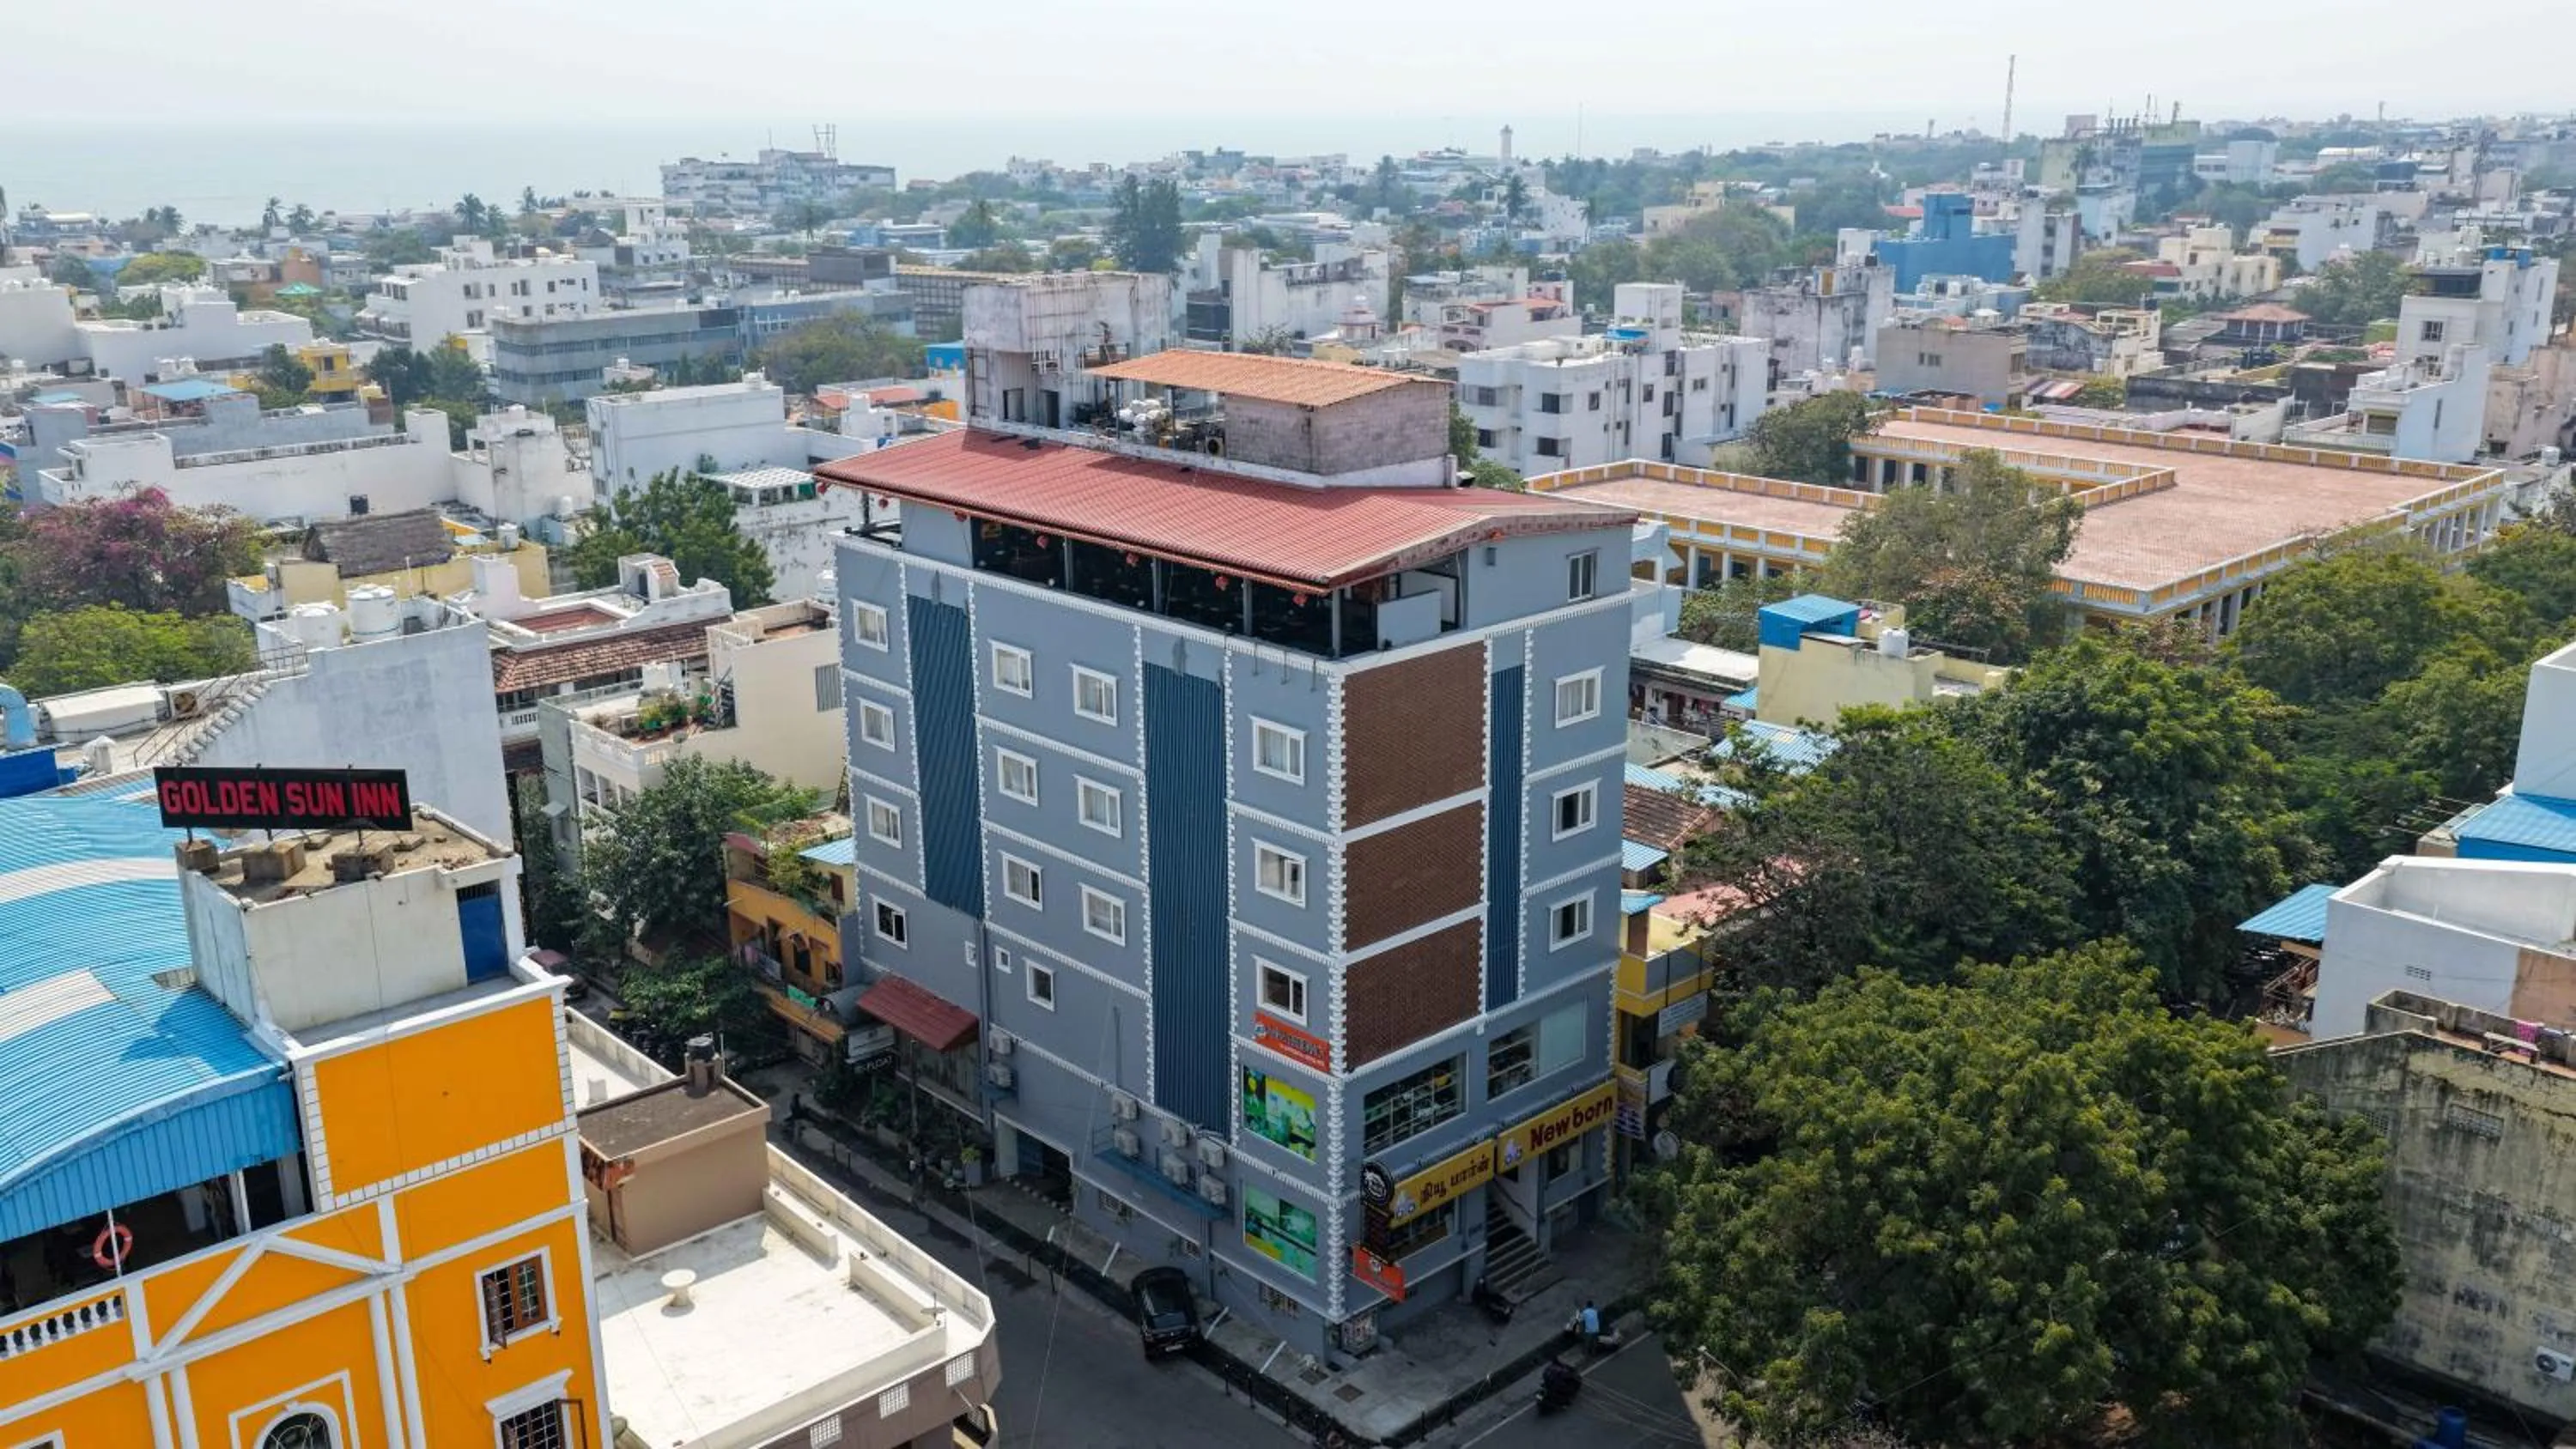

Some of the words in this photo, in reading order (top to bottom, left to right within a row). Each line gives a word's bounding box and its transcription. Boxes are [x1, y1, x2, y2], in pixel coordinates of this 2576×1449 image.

[161, 779, 280, 815] GOLDEN
[285, 781, 347, 816] SUN
[351, 782, 402, 817] INN
